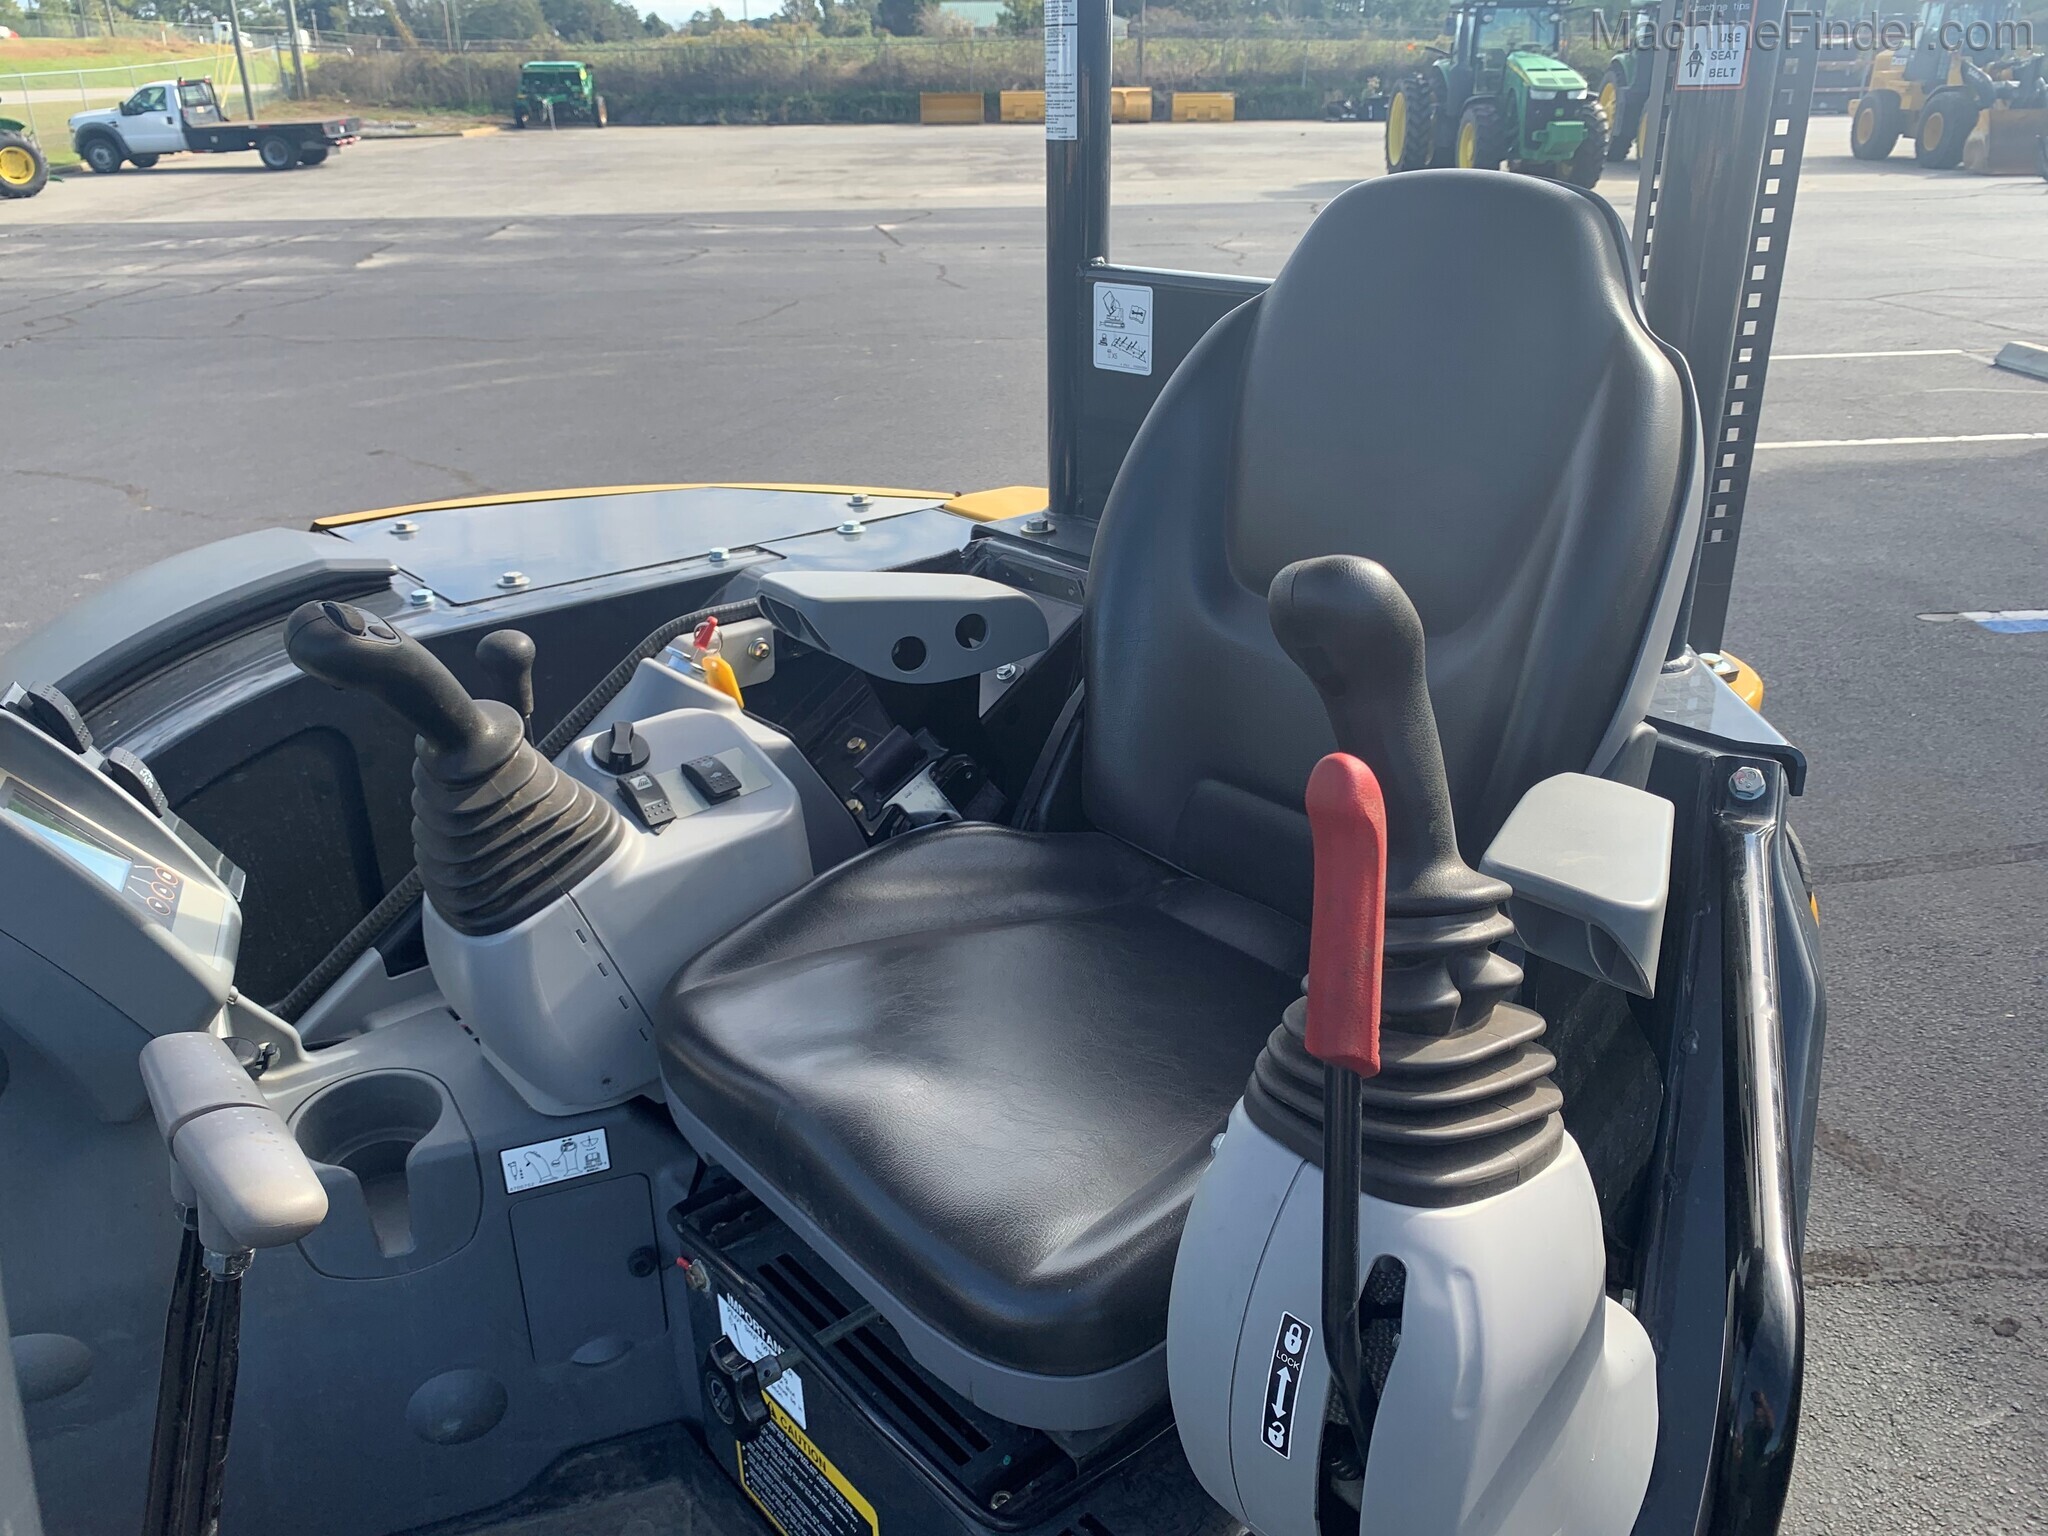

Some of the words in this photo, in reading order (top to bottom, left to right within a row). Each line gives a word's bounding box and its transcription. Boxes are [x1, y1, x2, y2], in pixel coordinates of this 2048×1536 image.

[1719, 32, 1741, 43] USE
[1710, 50, 1739, 61] SEAT
[1708, 67, 1737, 78] BELT
[1275, 1349, 1301, 1371] LOCK
[780, 1417, 827, 1473] CAUTION
